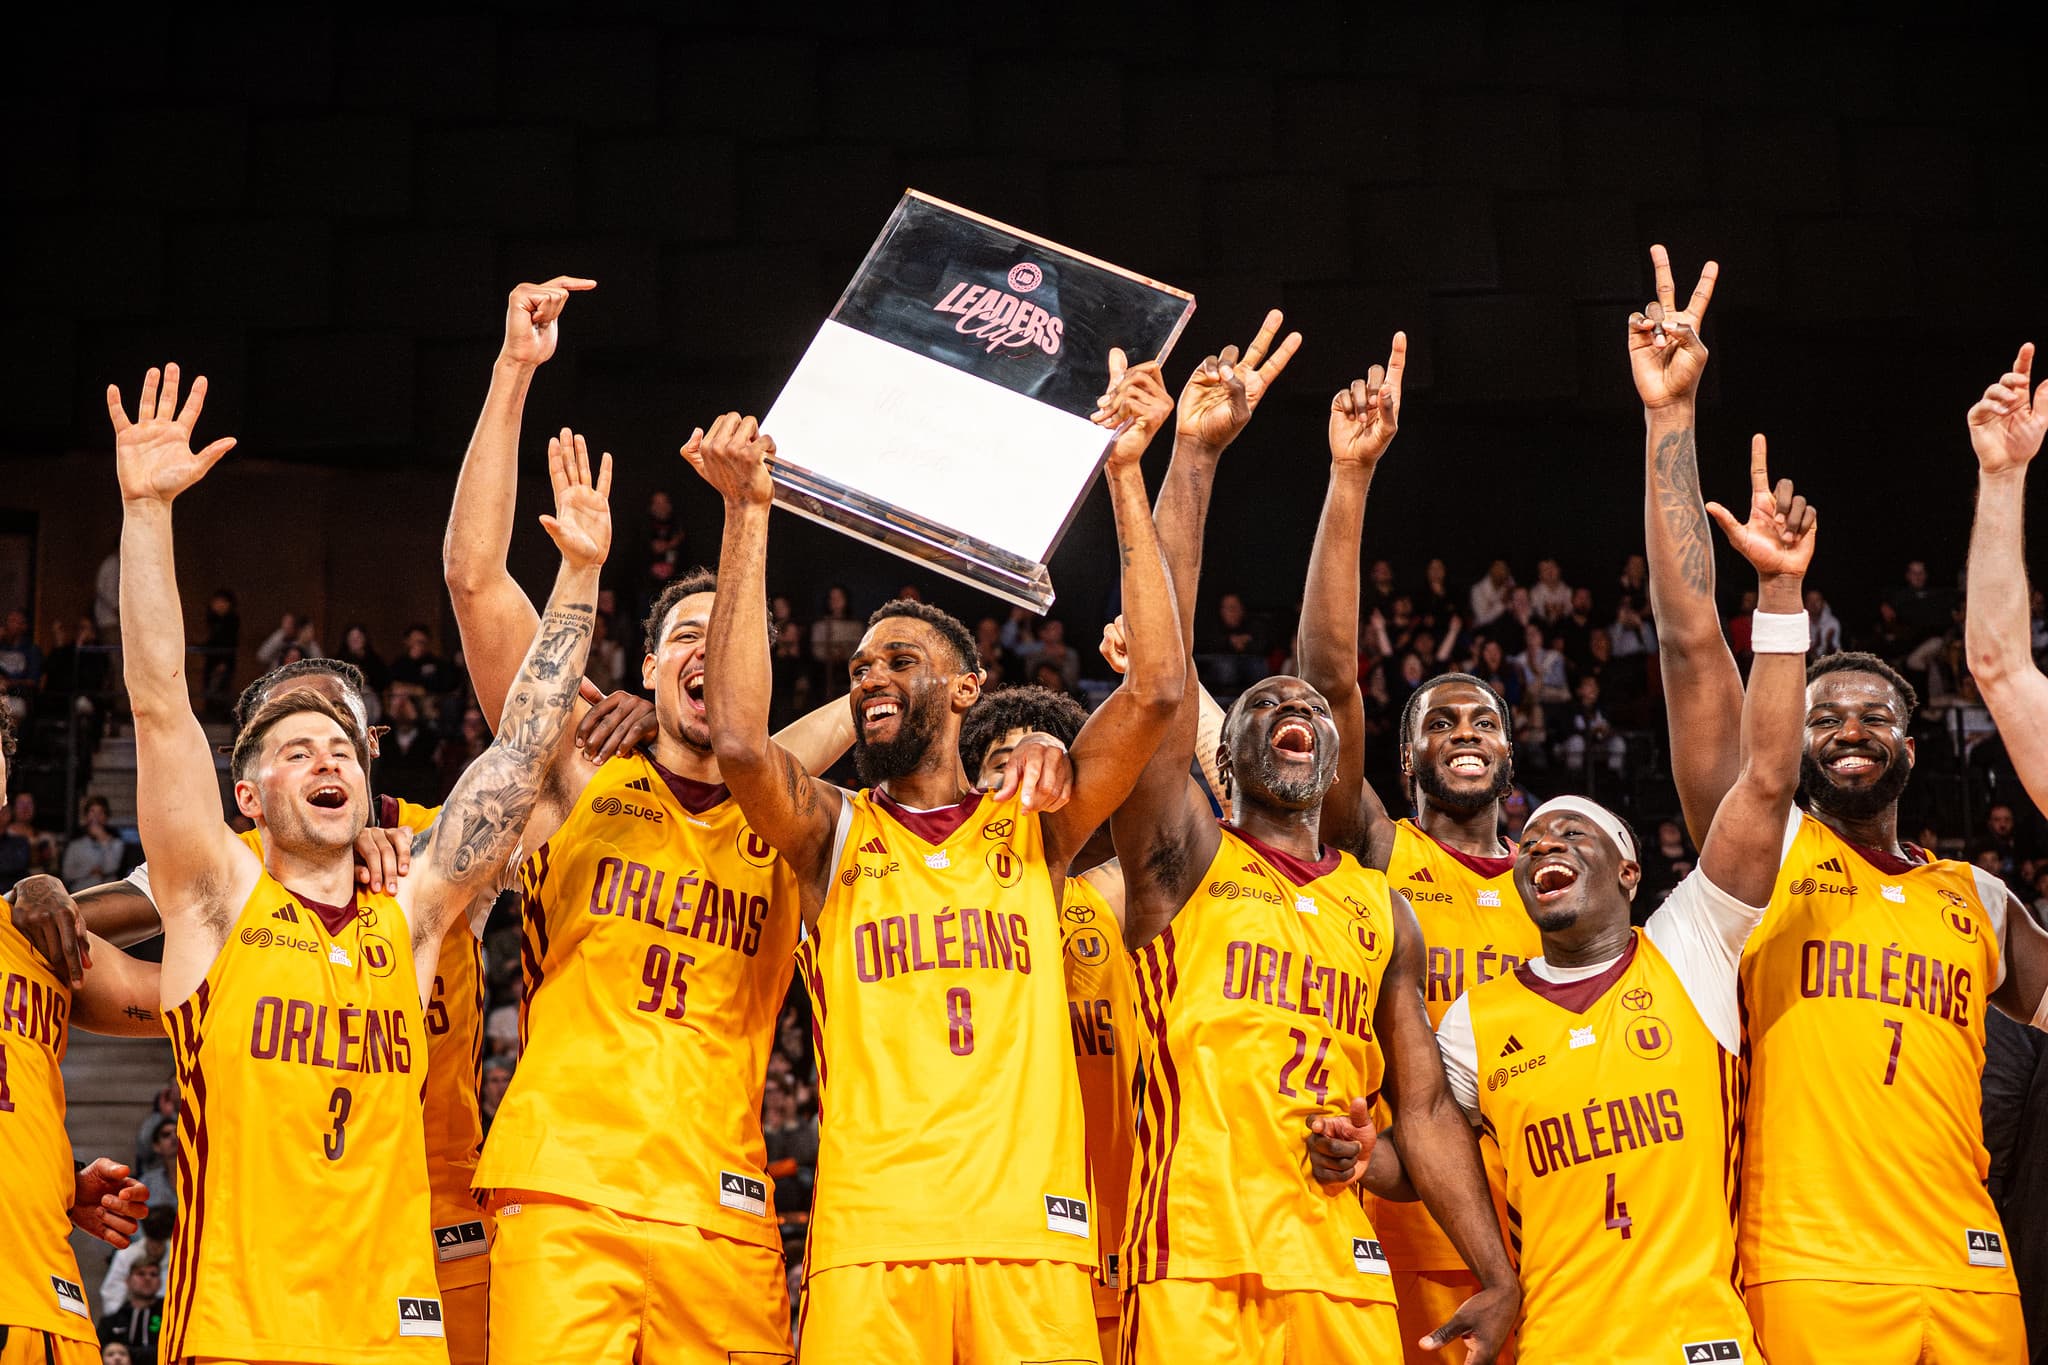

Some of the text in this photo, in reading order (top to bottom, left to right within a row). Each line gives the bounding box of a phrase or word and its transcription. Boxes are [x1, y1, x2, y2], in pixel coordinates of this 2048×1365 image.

[933, 281, 1064, 355] LEADERS
[955, 310, 1036, 354] Cup
[622, 802, 664, 824] suez
[996, 853, 1011, 878] U
[1241, 886, 1283, 905] suez
[1415, 892, 1453, 904] suez
[1818, 883, 1858, 896] suez
[590, 856, 770, 958] ORLÉANS
[275, 935, 319, 953] suez
[365, 945, 387, 968] U
[855, 906, 1032, 984] ORLÉANS
[1077, 936, 1100, 957] U
[0, 971, 66, 1054] ANS
[636, 944, 696, 1020] 95
[1801, 940, 1972, 1027] ORLÉANS
[946, 987, 975, 1057] 8
[1635, 1026, 1662, 1050] U
[1883, 1019, 1903, 1086] 7
[1278, 1027, 1331, 1106] 24
[1510, 1055, 1547, 1078] suez
[323, 1086, 353, 1161] 3
[1525, 1088, 1684, 1177] ORLÉANS
[1604, 1173, 1632, 1240] 4
